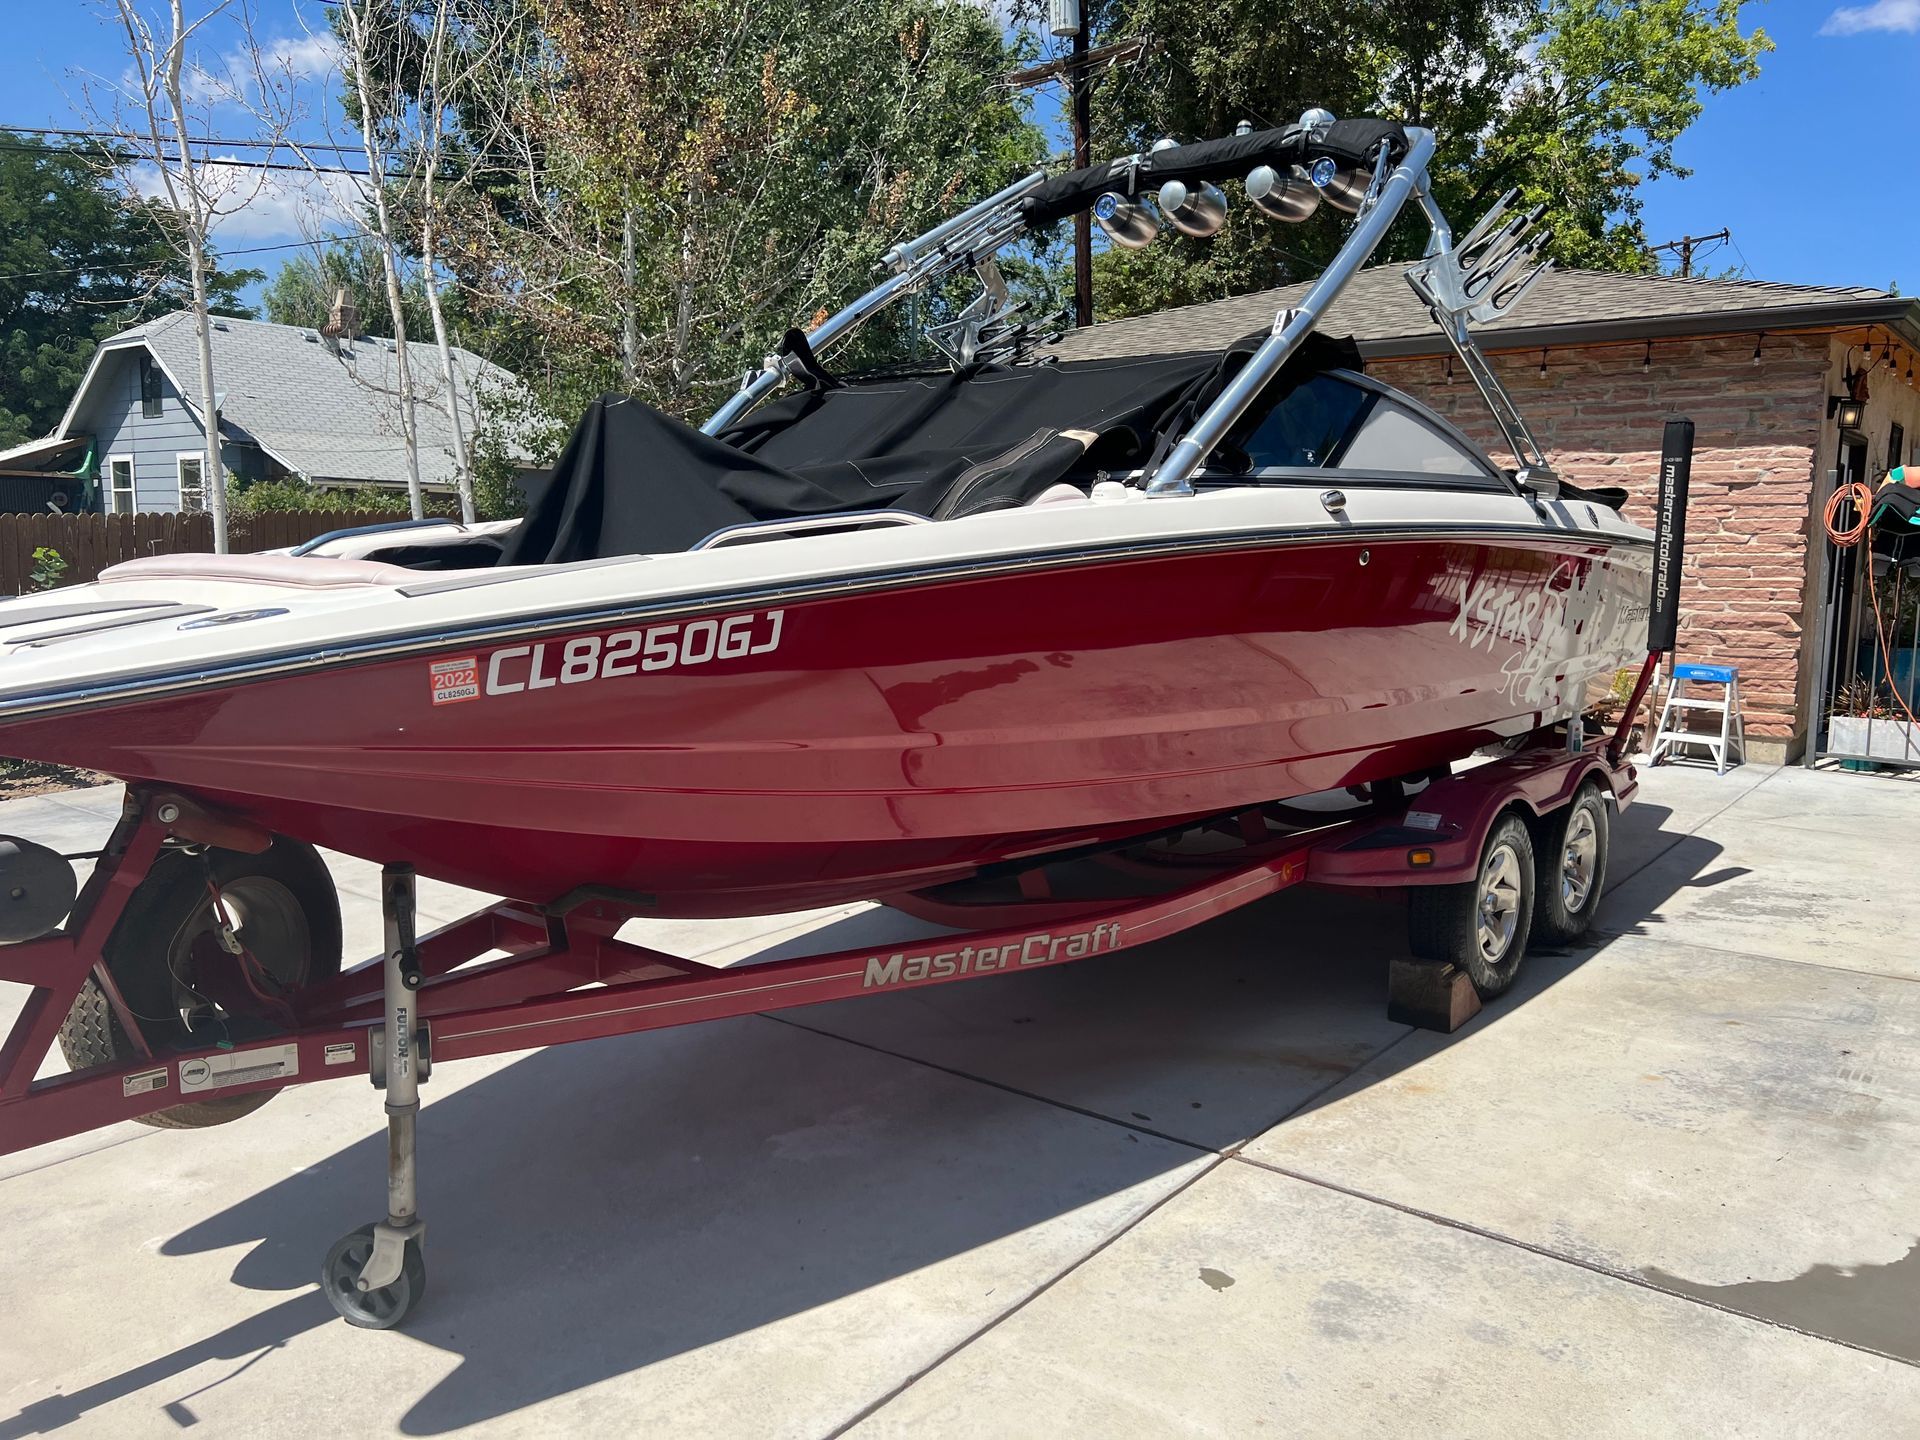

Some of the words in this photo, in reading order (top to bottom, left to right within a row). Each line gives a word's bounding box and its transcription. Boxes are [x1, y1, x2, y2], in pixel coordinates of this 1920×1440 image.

[1656, 465, 1677, 613] mastercraftcolorado.com
[434, 670, 476, 689] 2022
[485, 610, 785, 697] CL8250GJ
[437, 687, 476, 700] CL8250GJ
[863, 922, 1121, 988] MasterCraft
[396, 1007, 409, 1058] FULTON
